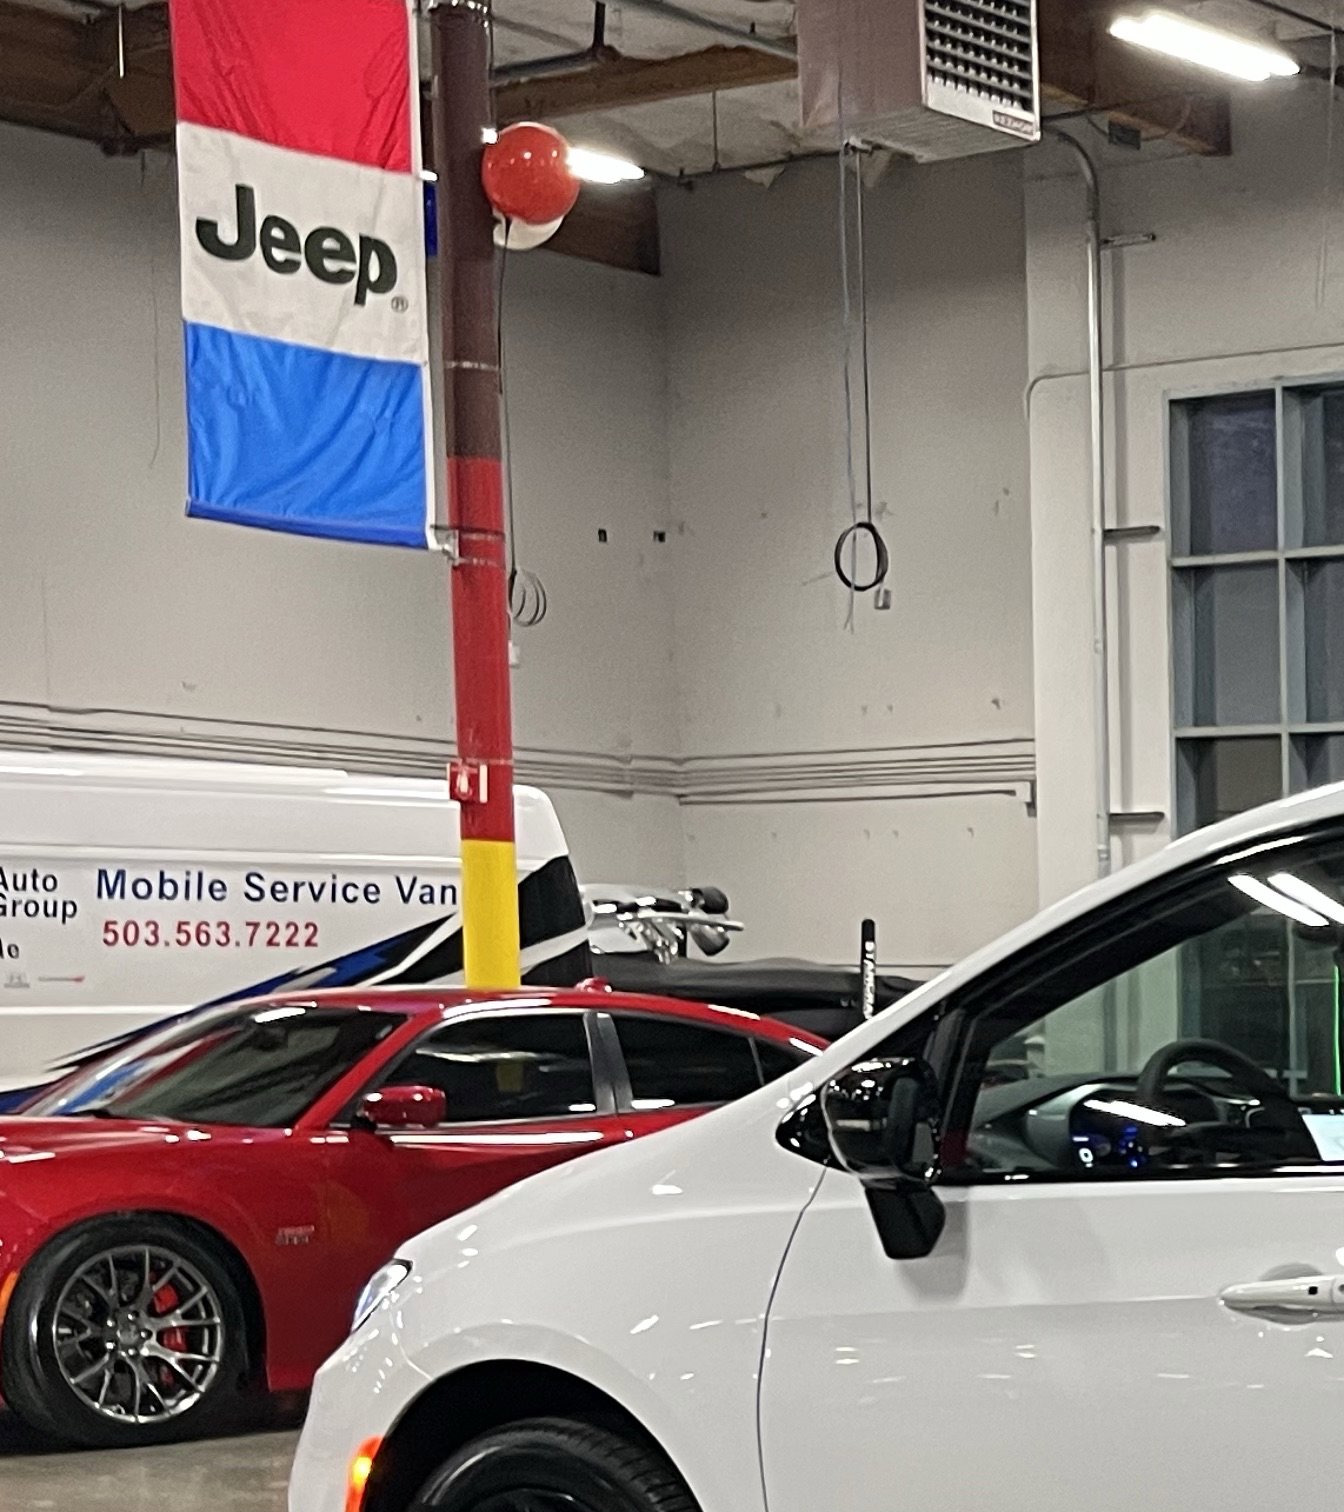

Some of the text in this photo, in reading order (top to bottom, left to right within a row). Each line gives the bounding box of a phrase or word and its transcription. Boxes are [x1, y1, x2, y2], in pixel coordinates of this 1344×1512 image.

[195, 183, 397, 307] Jeep
[97, 868, 457, 905] Mobile Service Van
[103, 919, 319, 948] 503.563.7222
